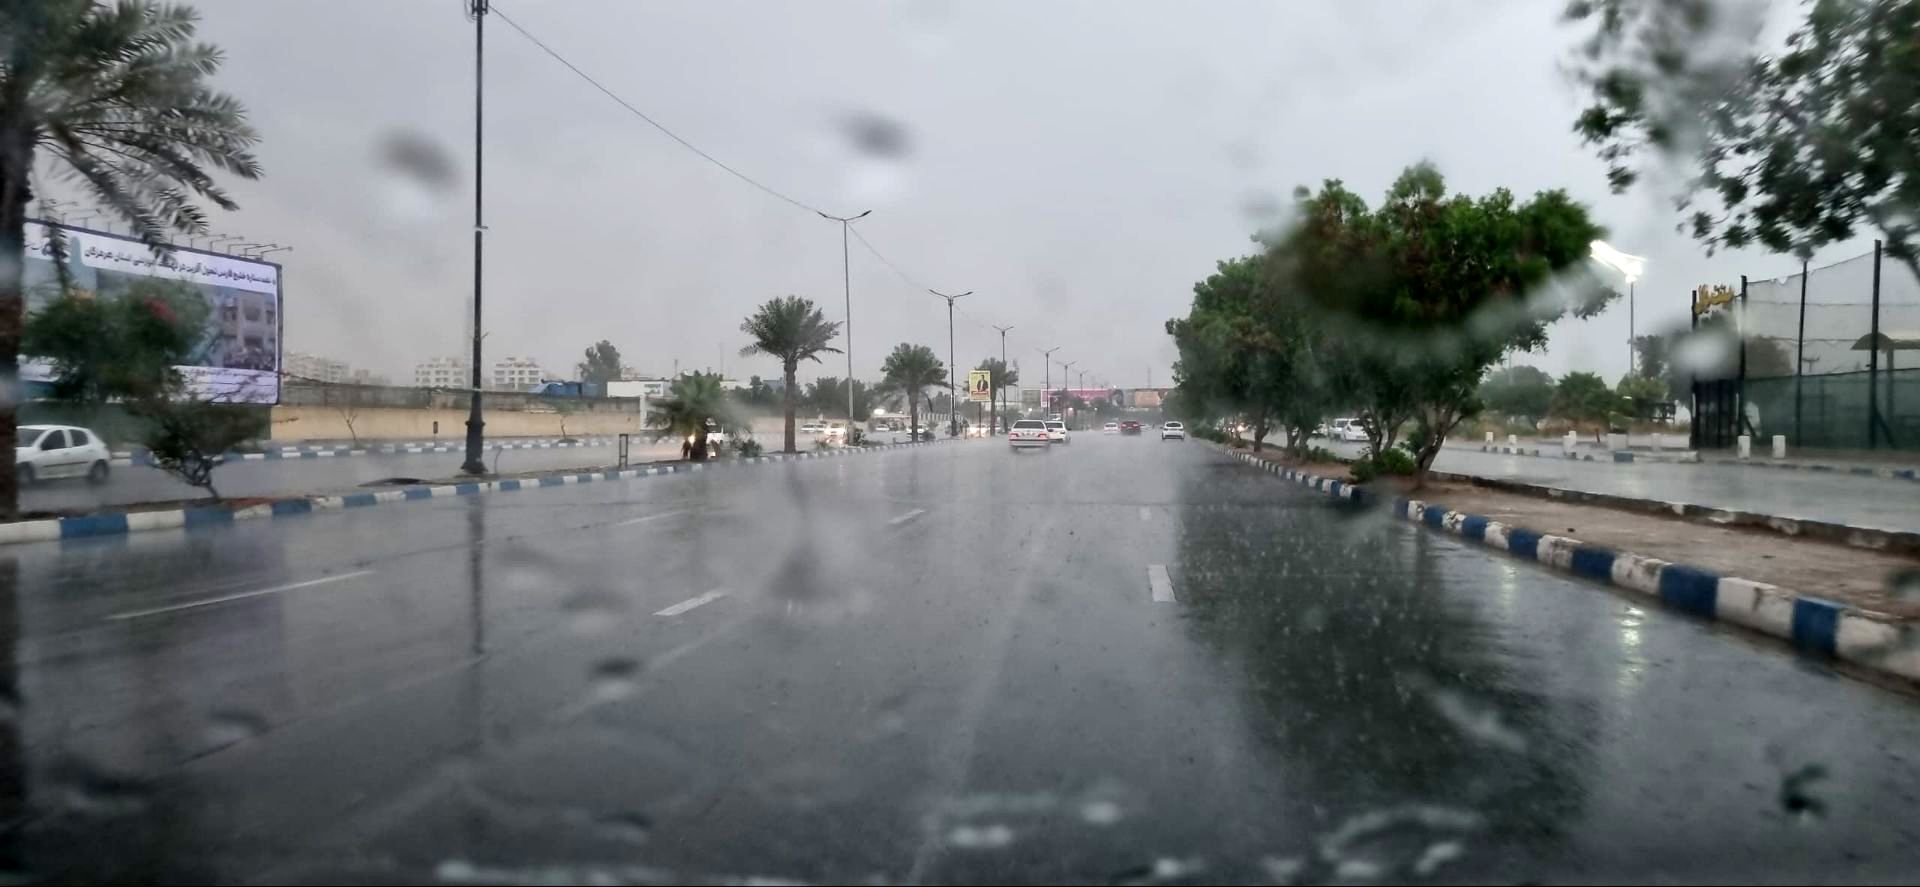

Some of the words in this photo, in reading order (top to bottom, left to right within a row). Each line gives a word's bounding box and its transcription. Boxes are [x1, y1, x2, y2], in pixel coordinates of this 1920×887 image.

[85, 247, 112, 259] هرمزگان
[218, 269, 232, 278] فارس
[233, 273, 246, 281] خلیج
